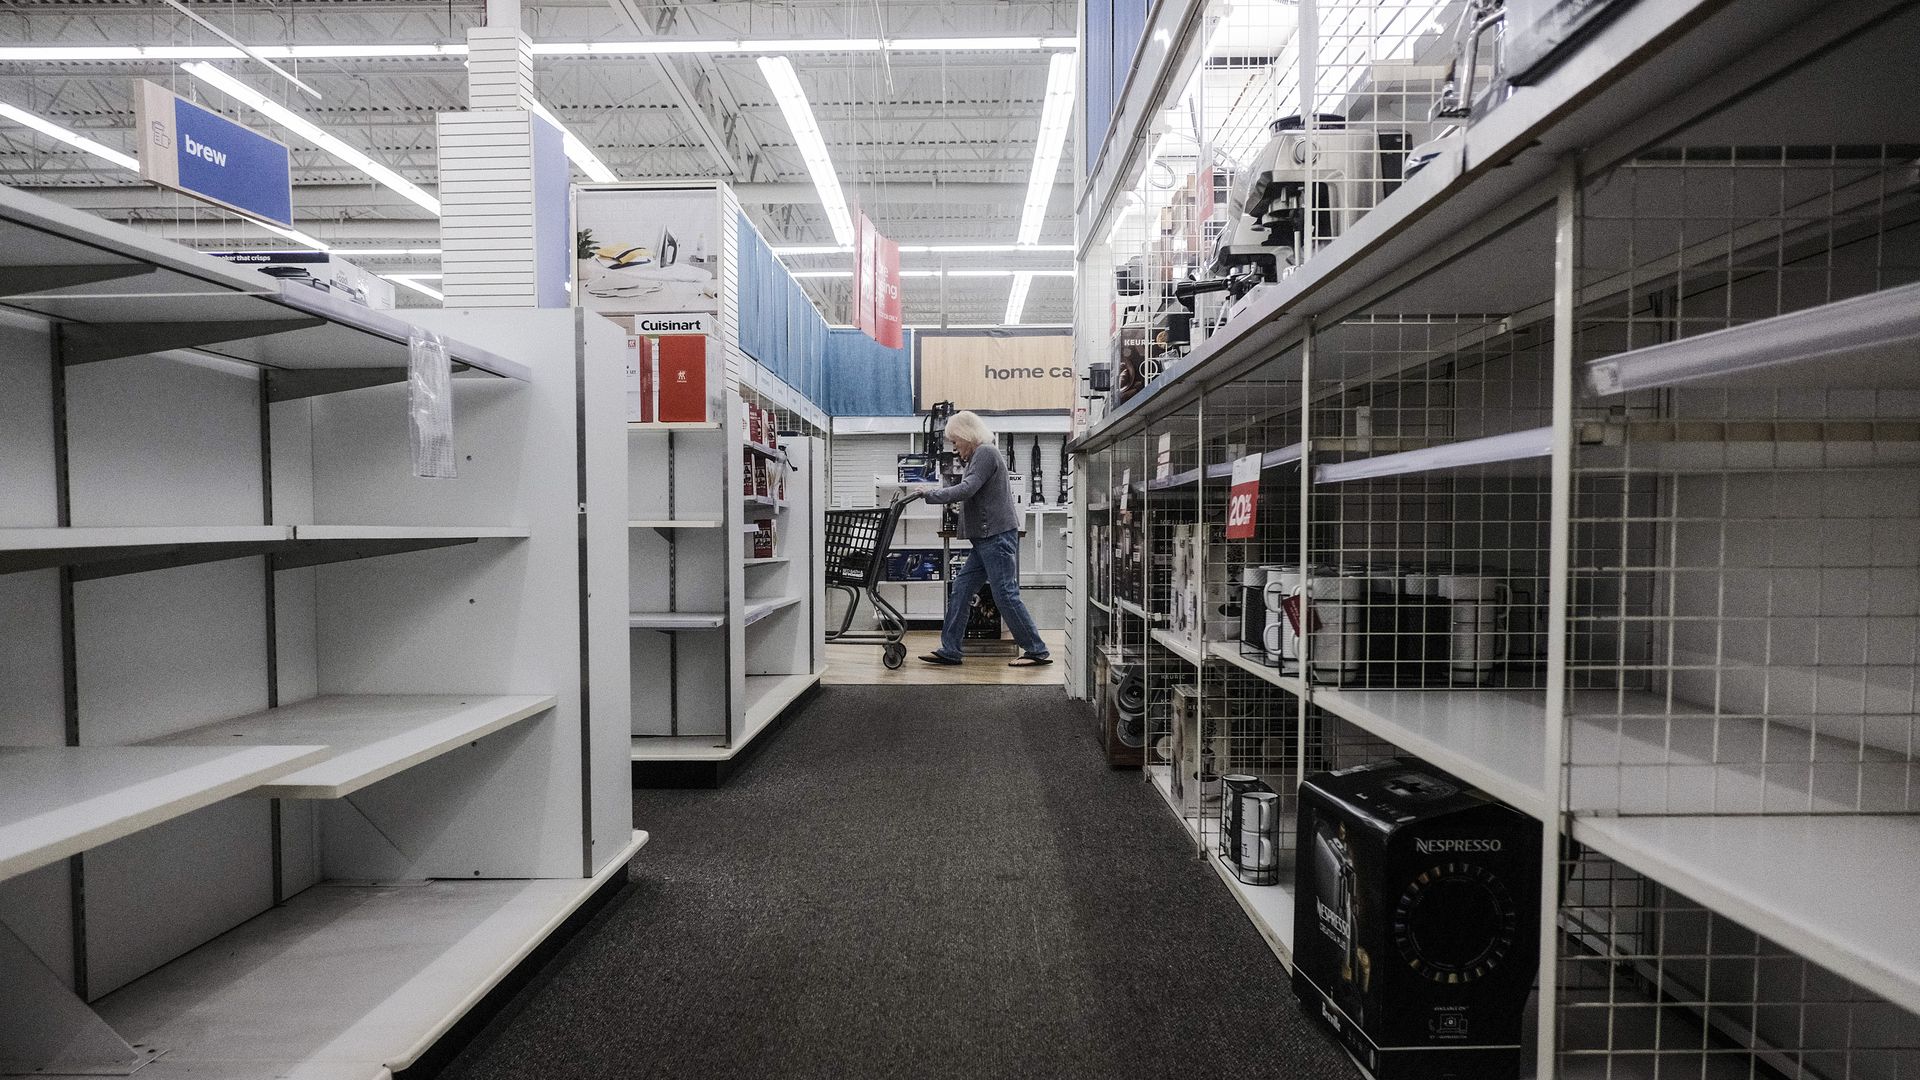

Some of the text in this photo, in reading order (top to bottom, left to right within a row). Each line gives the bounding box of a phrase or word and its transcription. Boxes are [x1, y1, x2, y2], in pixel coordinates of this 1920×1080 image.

[185, 134, 227, 167] brew
[250, 254, 271, 262] crisps
[641, 319, 702, 331] Cuisinart
[985, 364, 1044, 381] home
[1416, 838, 1502, 854] NESPRESSO
[1316, 895, 1351, 939] NESPRESSO
